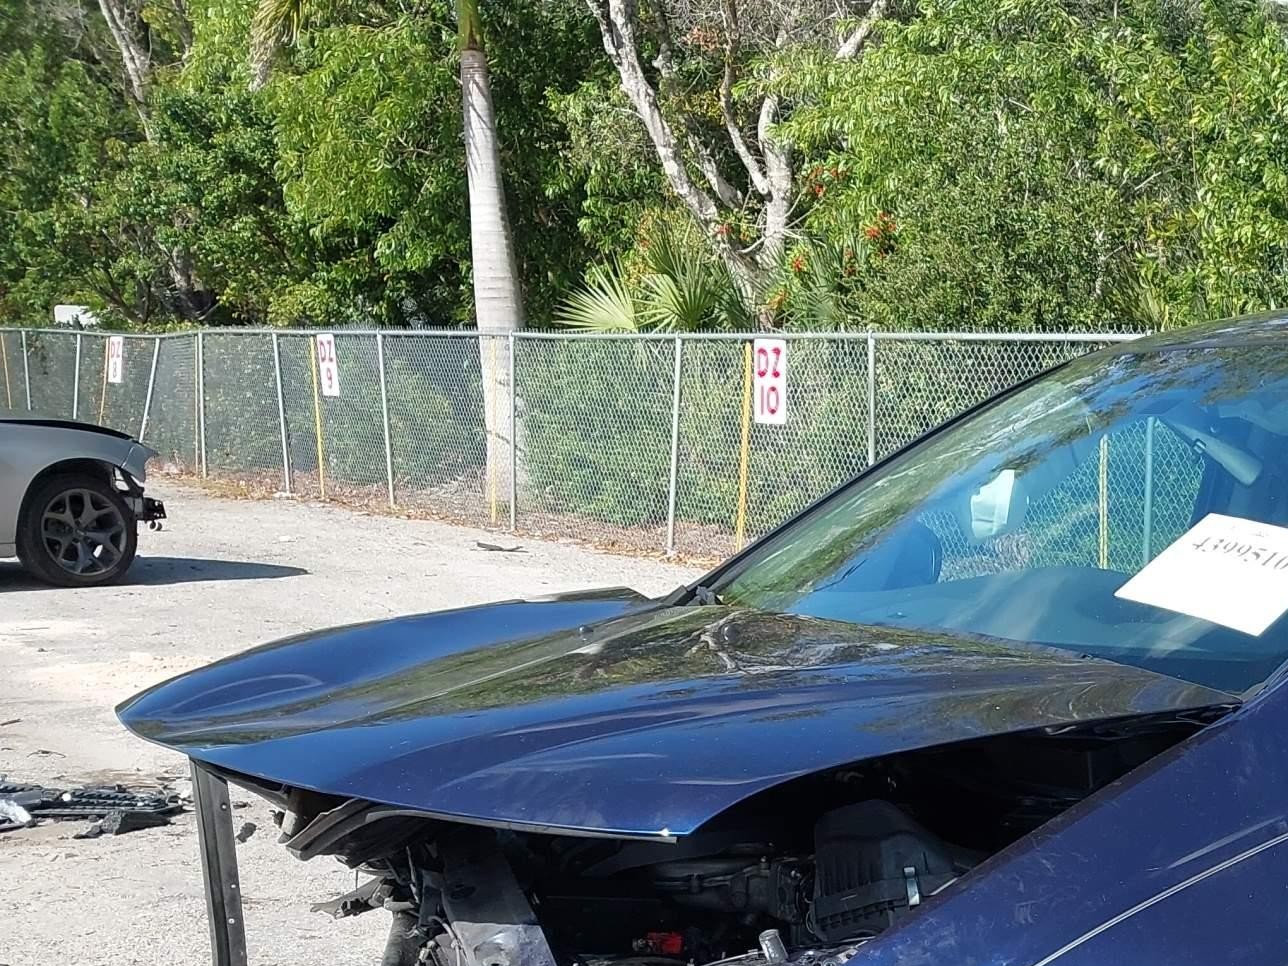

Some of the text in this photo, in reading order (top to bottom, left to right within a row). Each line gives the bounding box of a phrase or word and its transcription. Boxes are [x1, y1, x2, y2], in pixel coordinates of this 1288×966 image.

[110, 340, 121, 358] DZ
[319, 340, 333, 362] DZ
[757, 346, 781, 378] DZ
[326, 367, 333, 389] 9
[760, 385, 780, 415] 10
